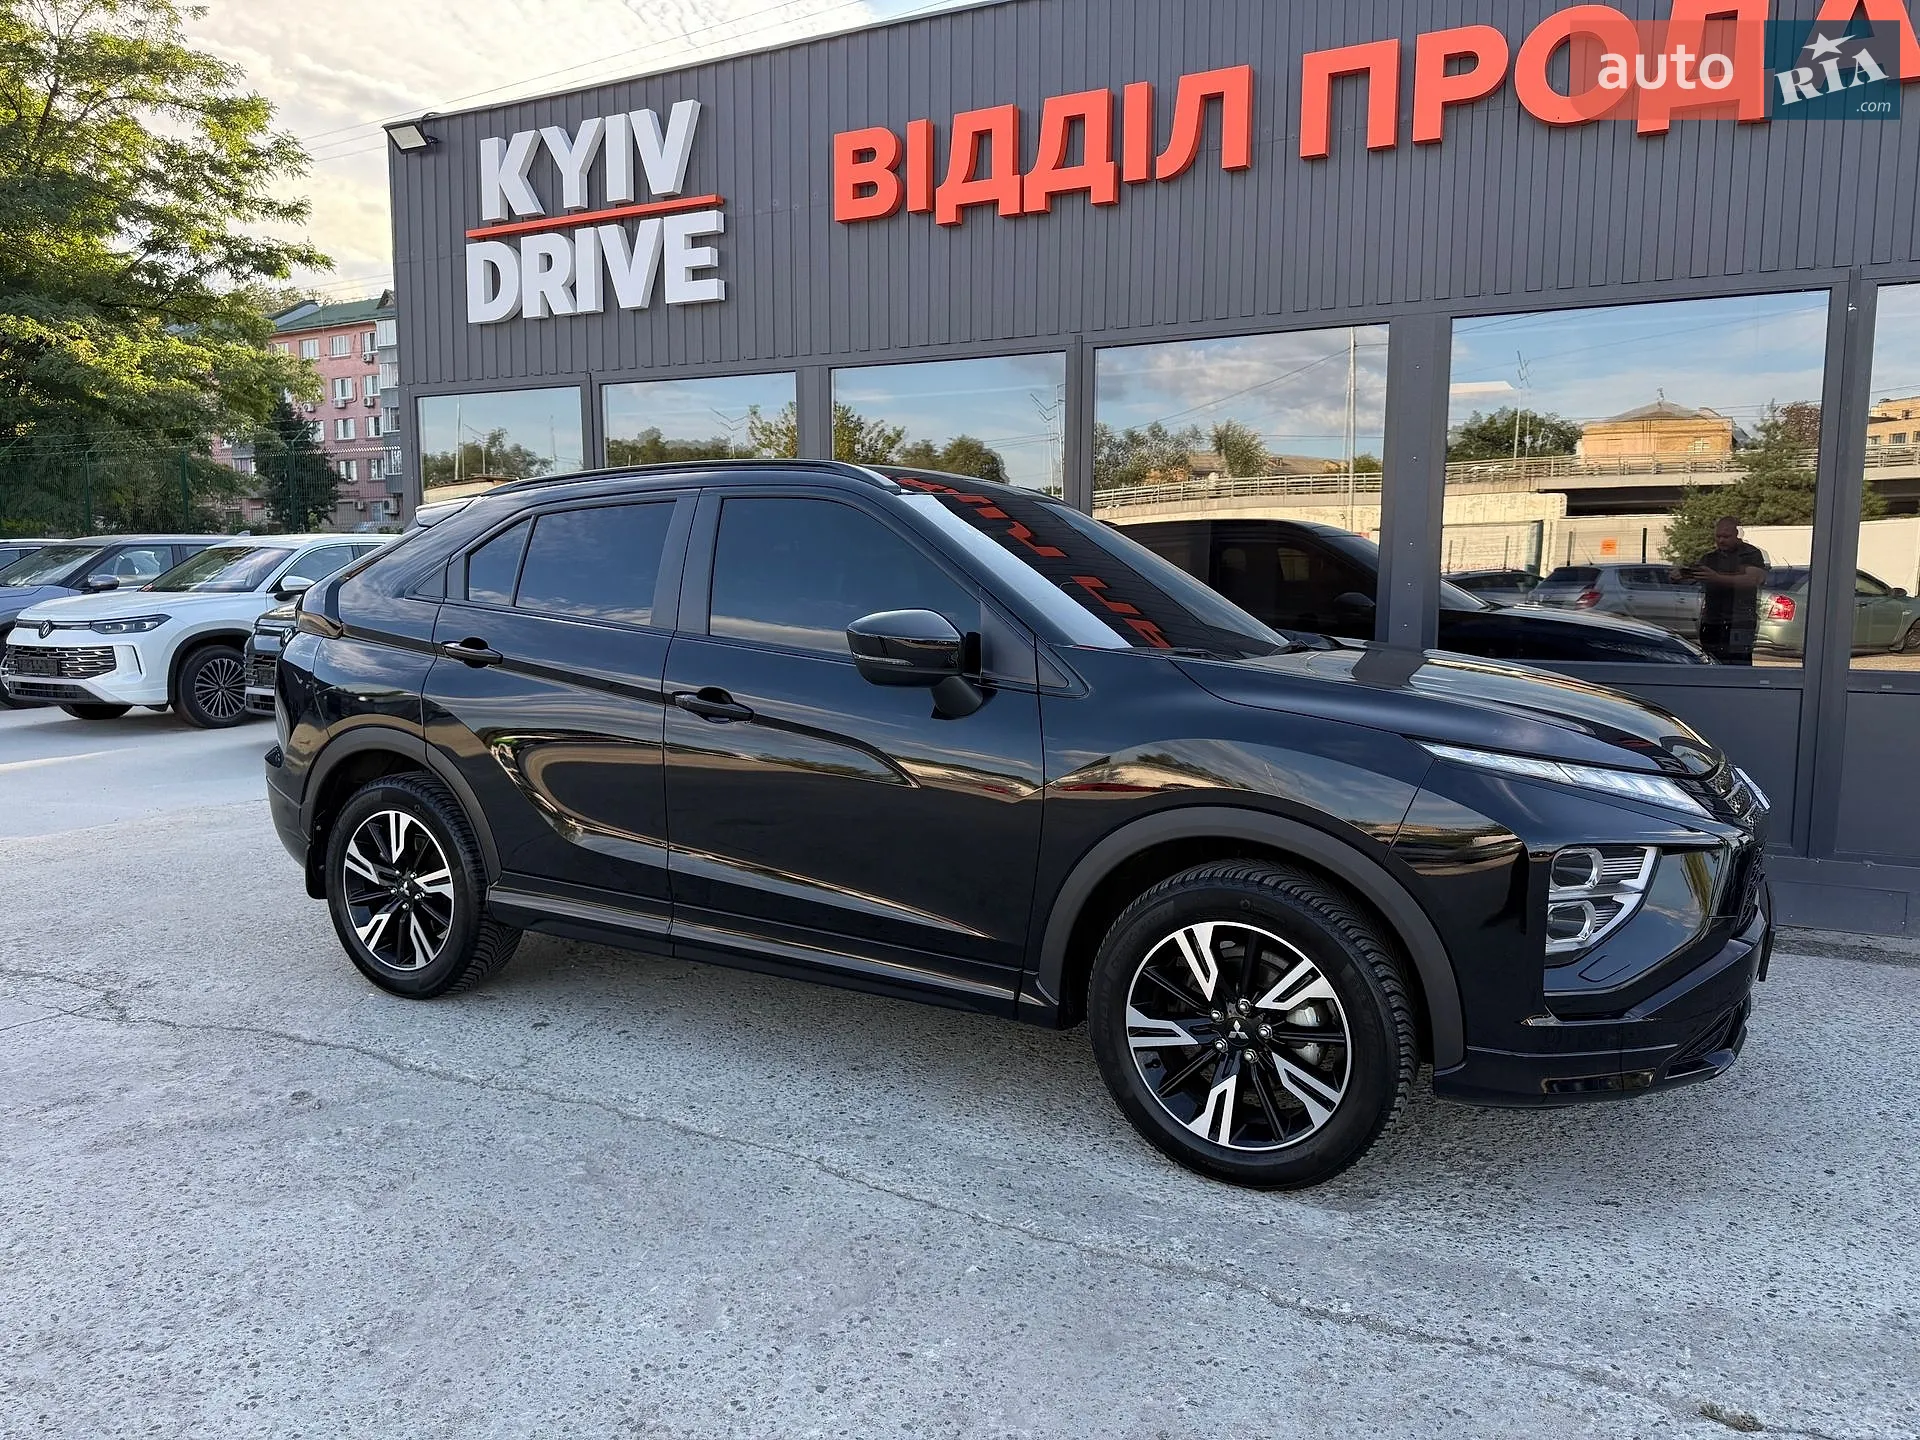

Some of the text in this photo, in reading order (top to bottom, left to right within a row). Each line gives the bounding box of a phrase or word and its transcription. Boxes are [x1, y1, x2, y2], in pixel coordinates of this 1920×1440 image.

[480, 99, 702, 222] KYIV
[834, 64, 1254, 226] ВІДДІЛ
[466, 209, 726, 325] DRIVE
